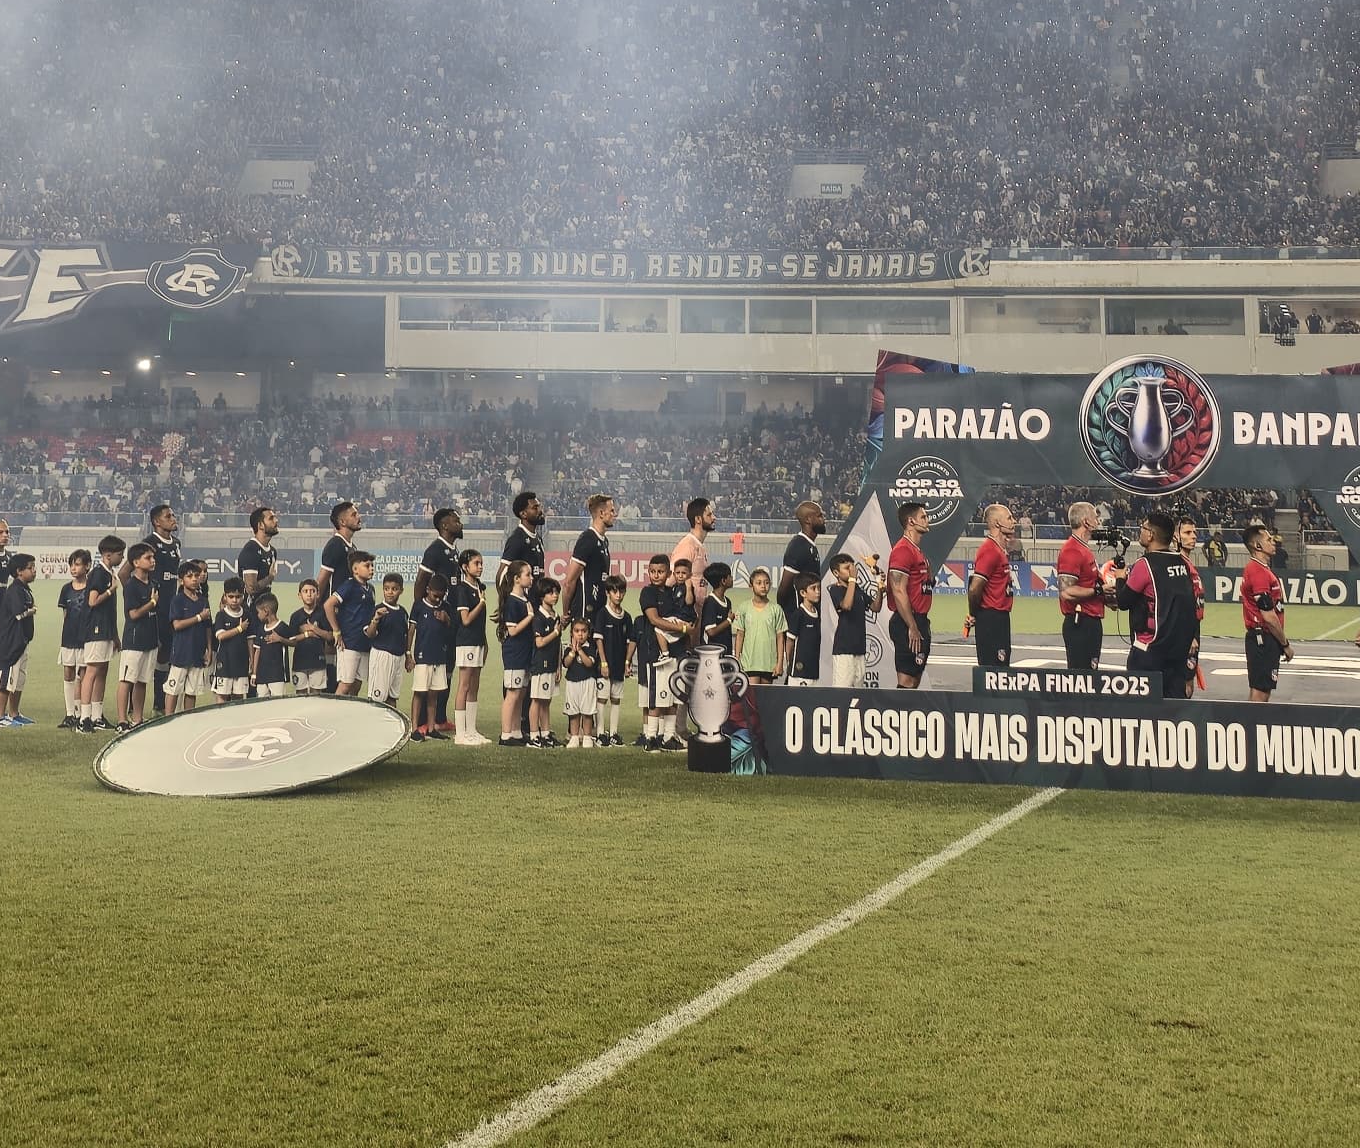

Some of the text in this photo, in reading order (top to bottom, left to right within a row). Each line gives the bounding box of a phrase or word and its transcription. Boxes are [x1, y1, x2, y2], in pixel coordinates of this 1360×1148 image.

[327, 250, 523, 276] RETROCEDER
[646, 253, 817, 279] RENDER-SE
[826, 252, 938, 278] JAMAIS
[894, 402, 1051, 441] PARAZÃO
[888, 486, 965, 498] NO PARÁ
[895, 478, 960, 489] COP 30
[1215, 573, 1348, 606] PAZÃO
[985, 671, 1151, 696] RExPA FINAL 2025
[784, 709, 803, 754] O
[812, 698, 945, 759] CLÁSSICO
[954, 713, 1027, 764] MAIS
[1036, 714, 1196, 771] DISPUTADO
[1206, 721, 1246, 772] DO
